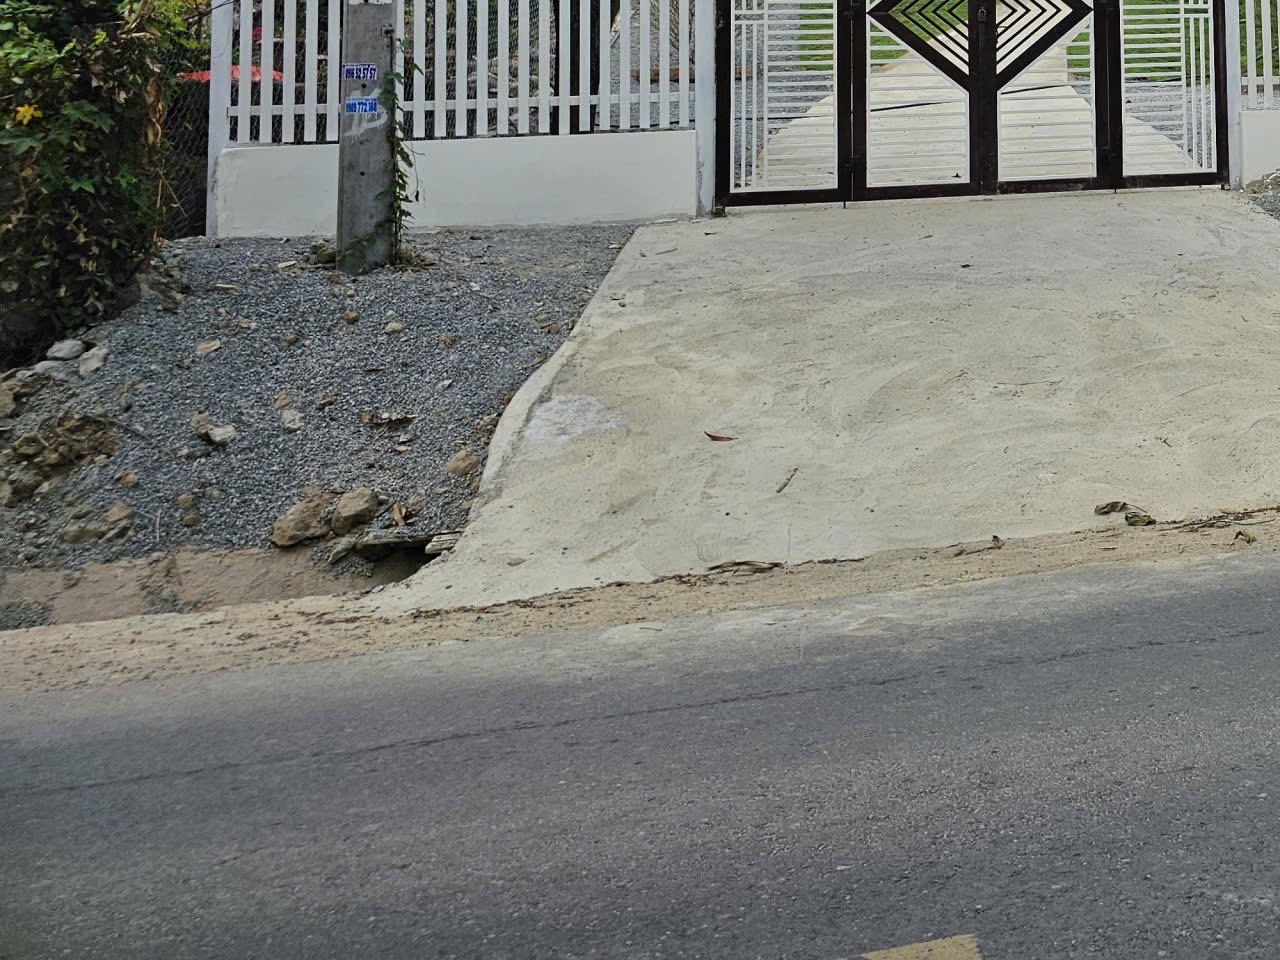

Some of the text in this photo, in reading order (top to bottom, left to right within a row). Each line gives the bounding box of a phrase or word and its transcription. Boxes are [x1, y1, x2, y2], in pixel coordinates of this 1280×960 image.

[362, 67, 369, 80] 57
[369, 67, 376, 80] 57
[357, 101, 367, 113] 772
